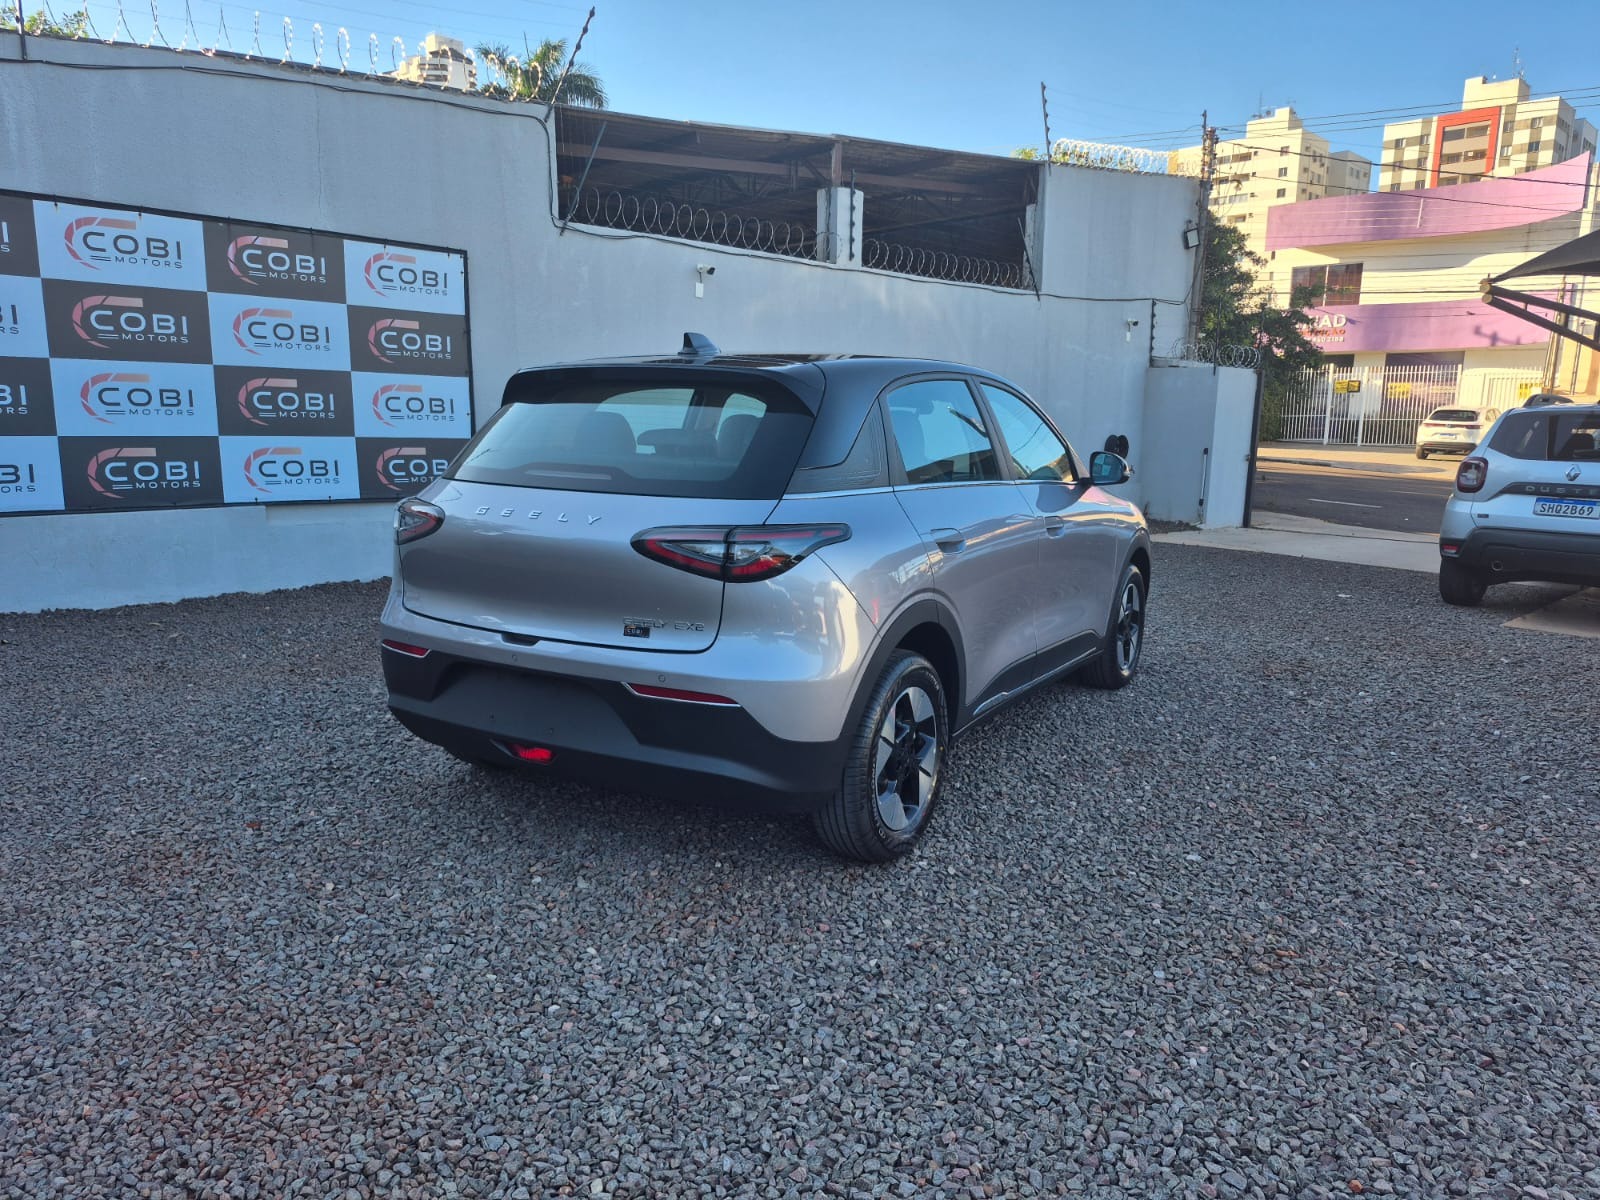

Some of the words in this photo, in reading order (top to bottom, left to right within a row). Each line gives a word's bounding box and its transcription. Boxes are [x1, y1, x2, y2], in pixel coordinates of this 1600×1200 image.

[82, 231, 182, 260] COBI
[115, 256, 183, 269] MOTORS
[242, 249, 326, 275] COBI
[268, 271, 327, 284] MOTORS
[377, 264, 448, 289] COBI
[399, 285, 448, 296] MOTORS
[90, 310, 188, 335] COBI
[122, 333, 189, 344] MOTORS
[247, 321, 330, 344] COBI
[274, 342, 331, 352] MOTORS
[380, 331, 451, 353] COBI
[403, 351, 452, 360] MOTORS
[0, 384, 27, 406] BI
[97, 387, 194, 408] COBI
[252, 391, 335, 411] COBI
[129, 408, 195, 416] MOTORS
[385, 396, 454, 414] COBI
[279, 411, 335, 419] MOTORS
[407, 414, 455, 422] MOTORS
[0, 463, 35, 484] BI
[104, 460, 200, 481] COBI
[258, 459, 339, 477] COBI
[388, 459, 448, 476] COB
[136, 480, 201, 489] MOTORS
[285, 477, 340, 485] MOTORS
[411, 476, 434, 484] MOT
[0, 485, 36, 494] ORS
[475, 506, 602, 525] GEELY
[1540, 503, 1594, 516] SHQ2B69
[674, 620, 705, 632] EX2
